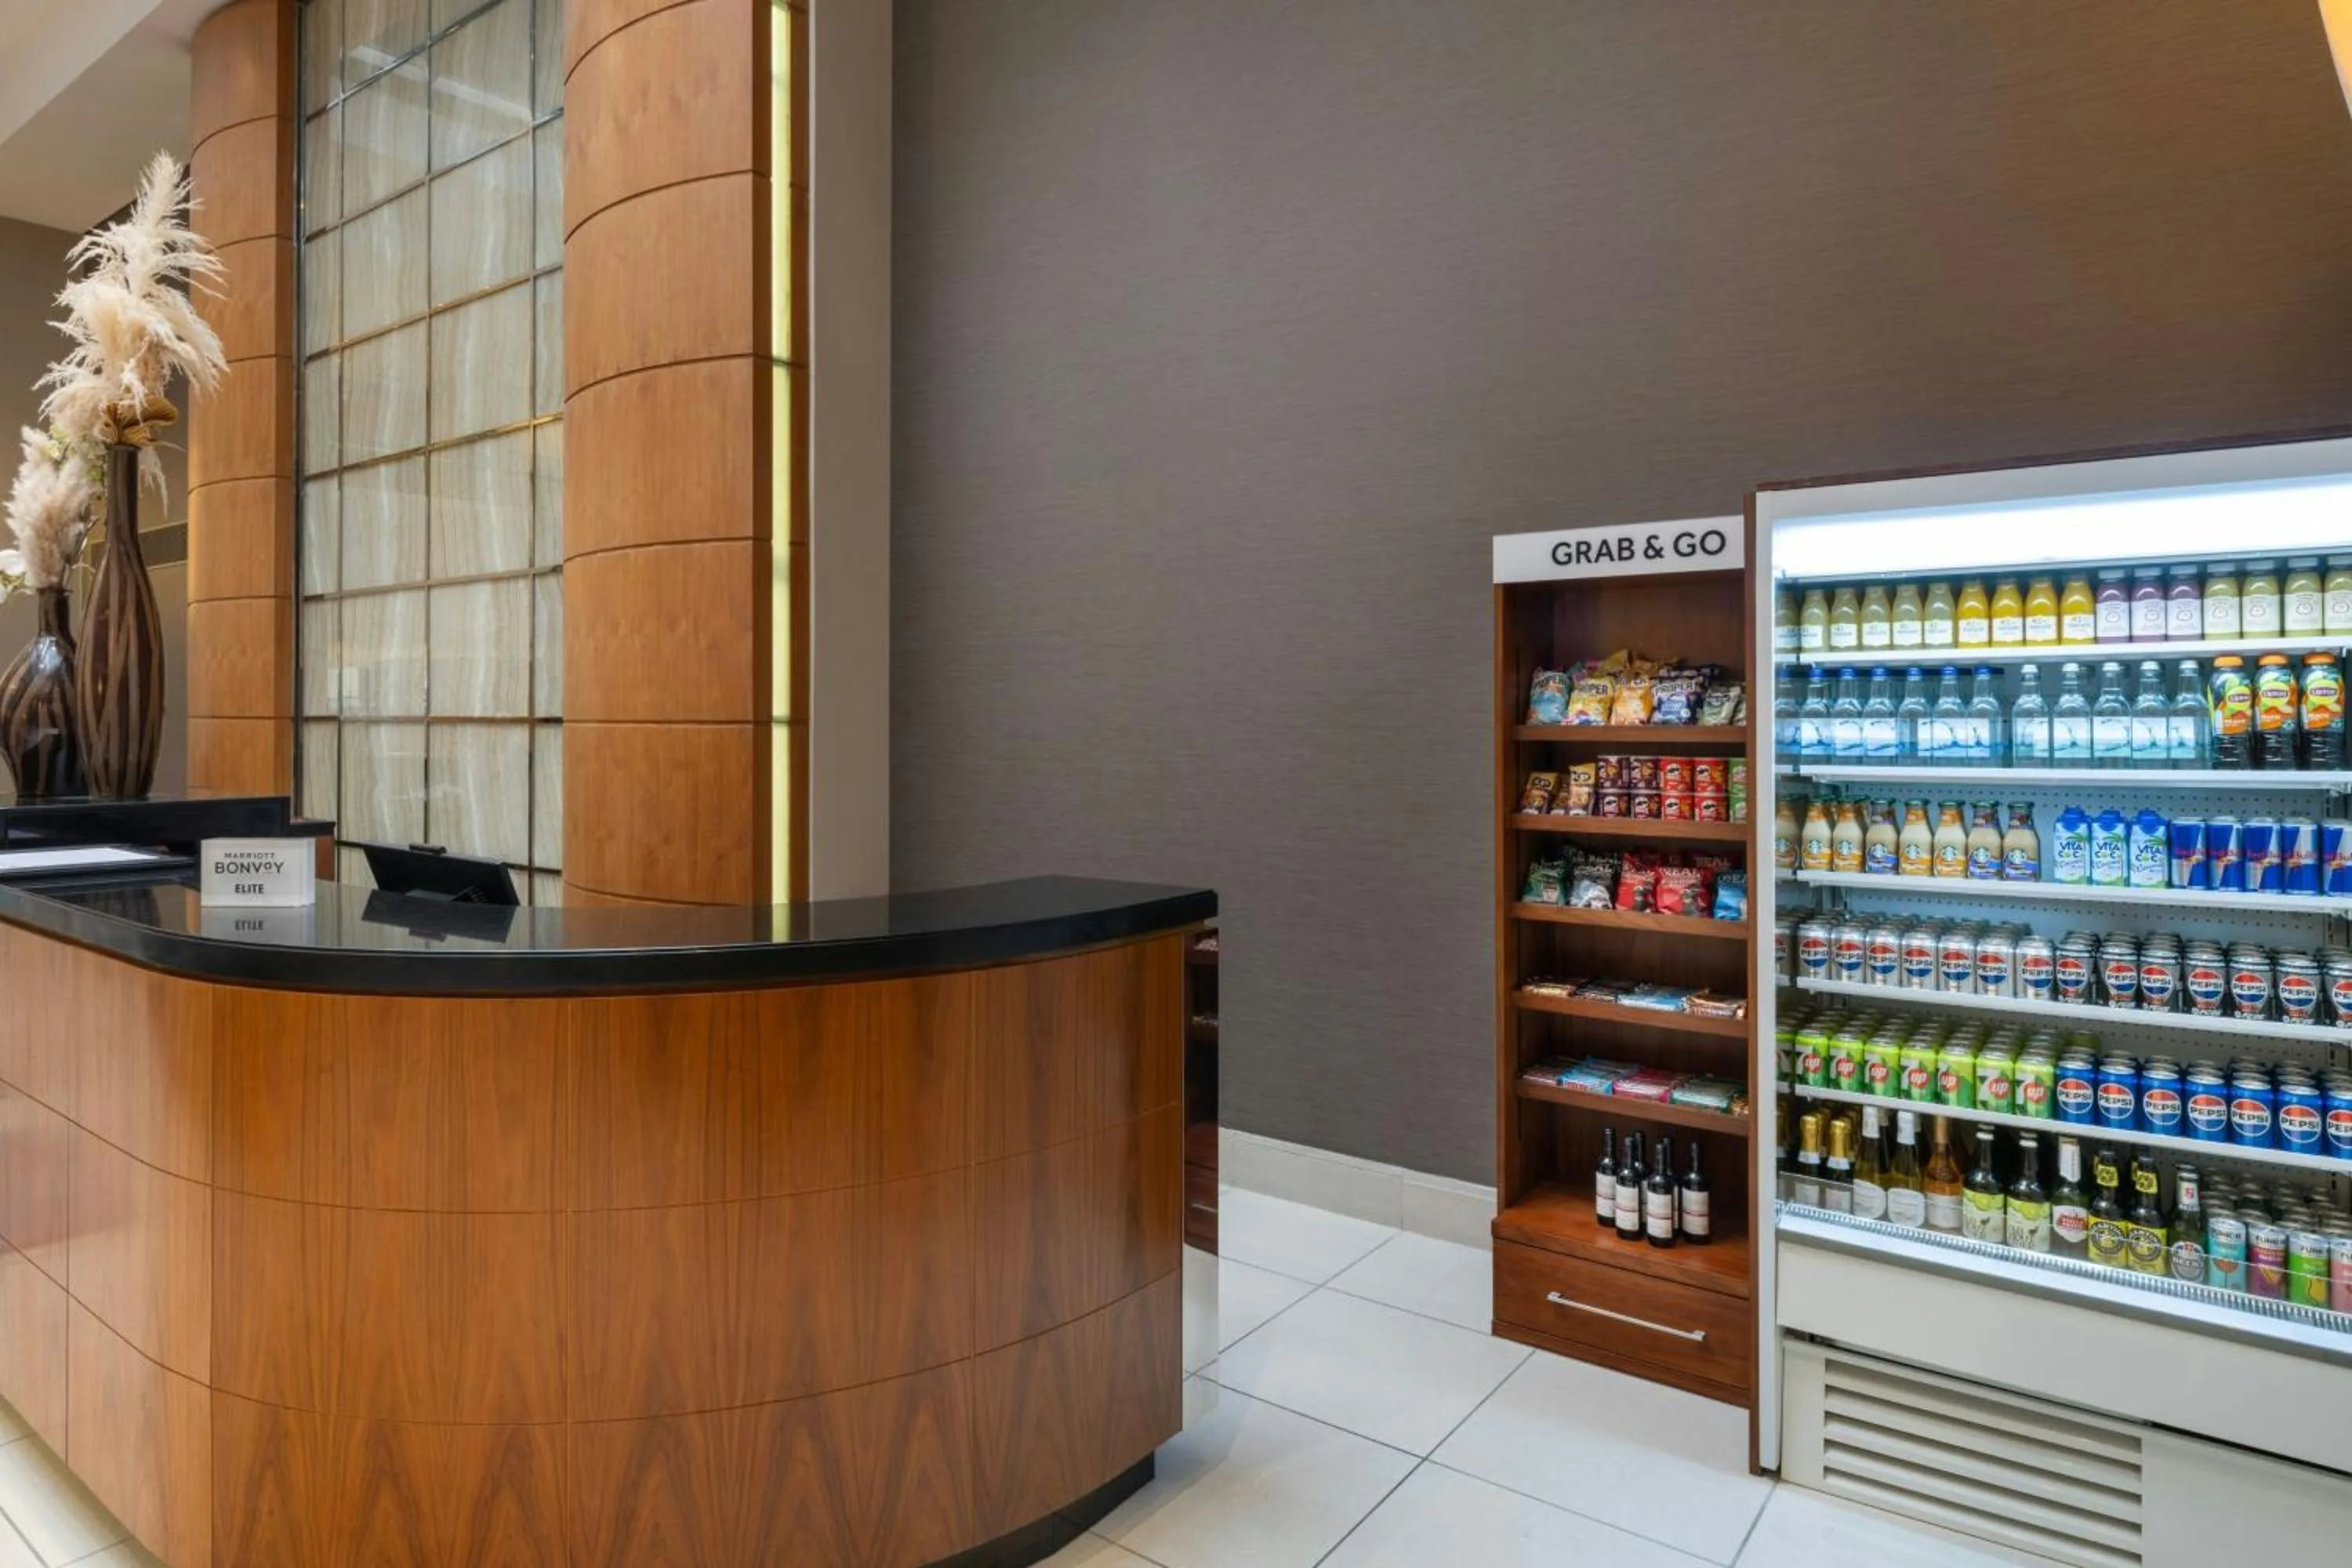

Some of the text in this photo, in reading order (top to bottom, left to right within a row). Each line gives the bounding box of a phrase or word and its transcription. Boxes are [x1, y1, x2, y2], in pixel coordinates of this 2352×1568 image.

[1552, 530, 1726, 565] GRAB & GO
[2059, 840, 2083, 851] VITA
[2096, 841, 2120, 851] VITA
[2137, 845, 2161, 854] VITA
[234, 884, 264, 895] ELITE
[1835, 952, 1864, 960] PEPSI
[1868, 955, 1896, 964] PEPSI
[1904, 957, 1933, 967] PEPSI
[1940, 960, 1972, 971] PEPSI
[1977, 964, 2008, 974] PEPSI
[2022, 967, 2053, 978] PEPSI
[2056, 969, 2085, 978] PEPSI
[2107, 973, 2137, 982] PEPSI
[2142, 976, 2172, 985] PEPSI
[2190, 980, 2223, 990] PEPSI
[2234, 983, 2267, 993] PEPSI
[2280, 986, 2315, 996] PEPSI
[2057, 1090, 2092, 1101] PEPSI
[2098, 1094, 2133, 1107] PEPSI
[2145, 1101, 2180, 1112] PEPSI
[2190, 1106, 2227, 1118] PEPSI
[2232, 1111, 2269, 1123] PEPSI
[2280, 1116, 2319, 1130] PEPSI
[2328, 1122, 2352, 1134] PEP
